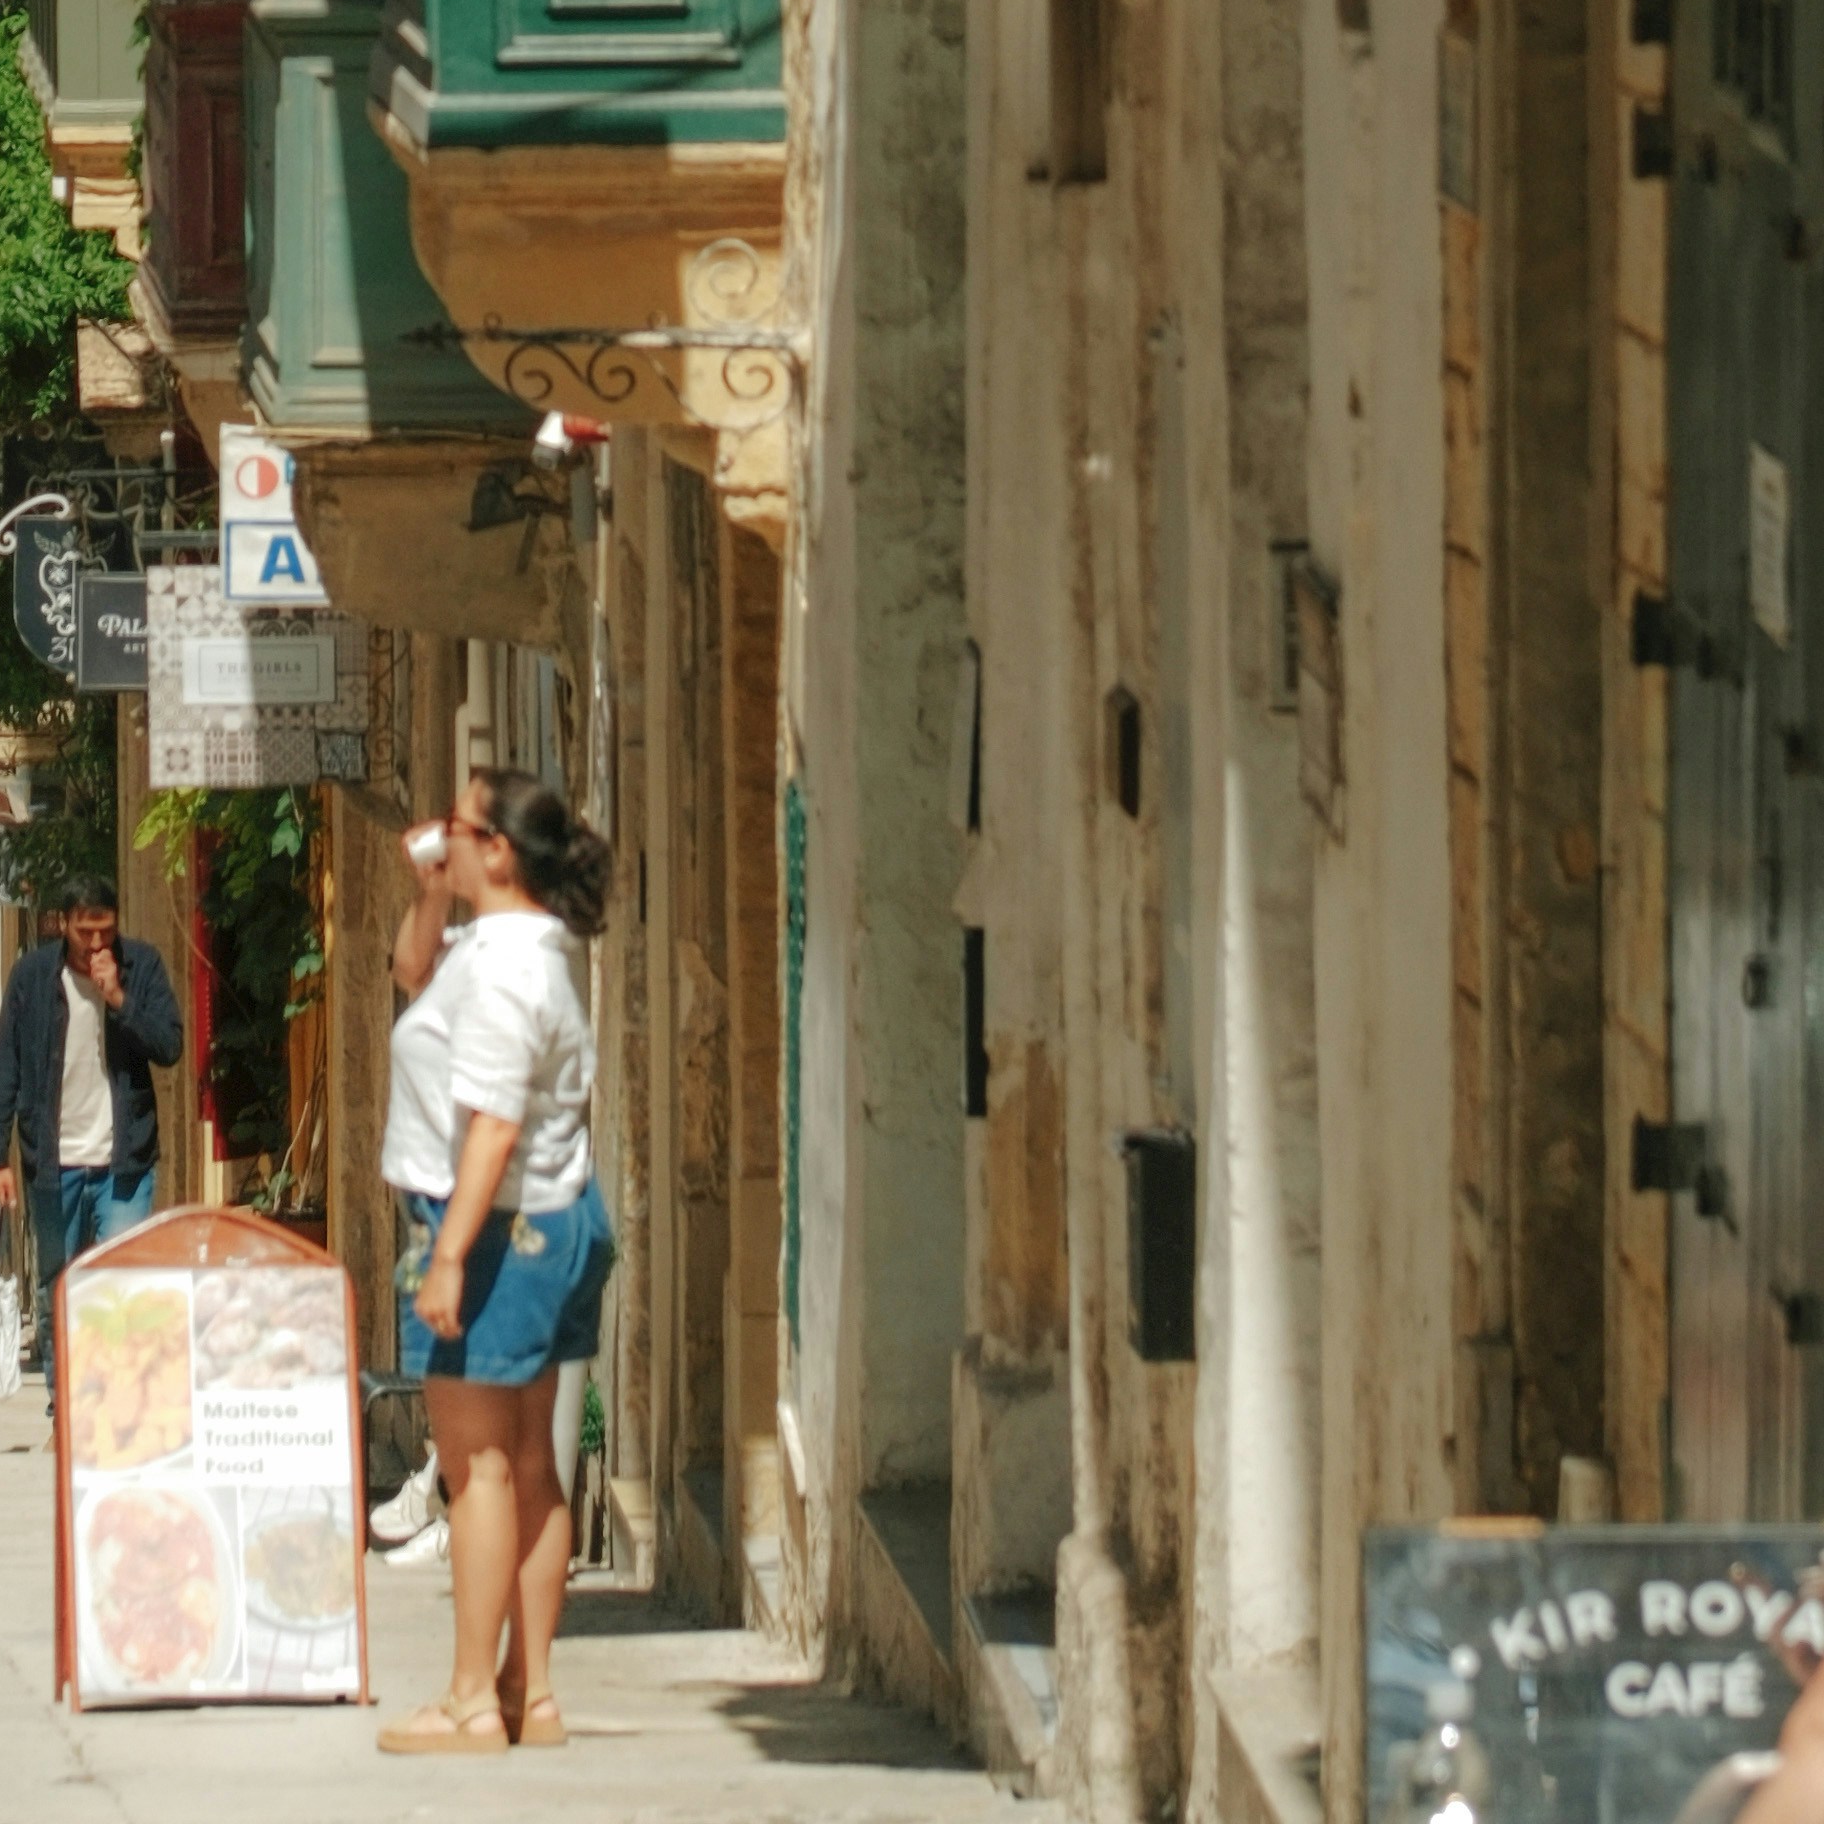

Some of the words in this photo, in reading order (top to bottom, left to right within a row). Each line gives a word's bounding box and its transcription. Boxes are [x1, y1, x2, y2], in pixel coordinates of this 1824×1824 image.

[260, 535, 322, 584] A
[97, 614, 147, 638] PAL
[253, 661, 303, 673] GIRLS
[203, 1401, 298, 1419] Maltese
[205, 1429, 333, 1446] Traditional
[205, 1457, 264, 1473] Food
[1489, 1589, 1618, 1670] KIR
[1605, 1651, 1766, 1719] CAFÉ
